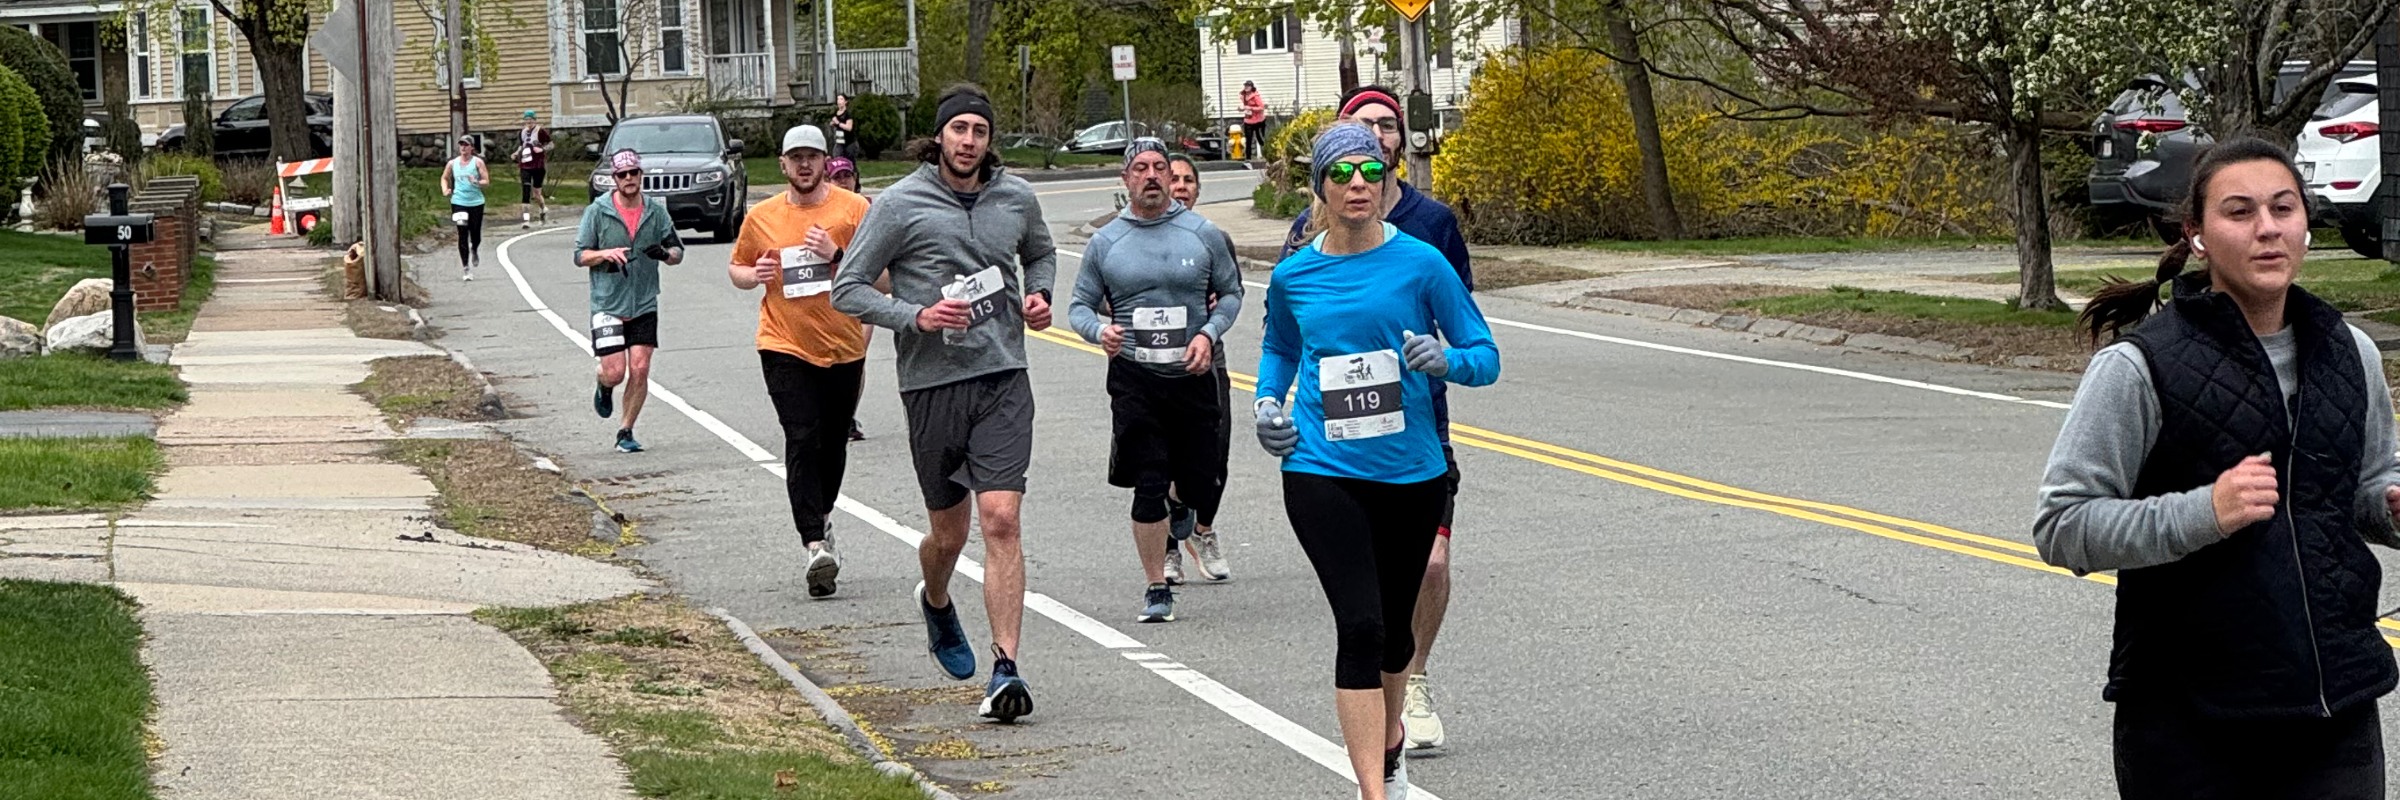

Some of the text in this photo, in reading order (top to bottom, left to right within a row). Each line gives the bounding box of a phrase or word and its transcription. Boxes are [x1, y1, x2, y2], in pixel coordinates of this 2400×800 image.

[117, 225, 132, 240] 50
[798, 267, 813, 280] 50
[1151, 332, 1169, 345] 25
[1343, 390, 1381, 412] 119
